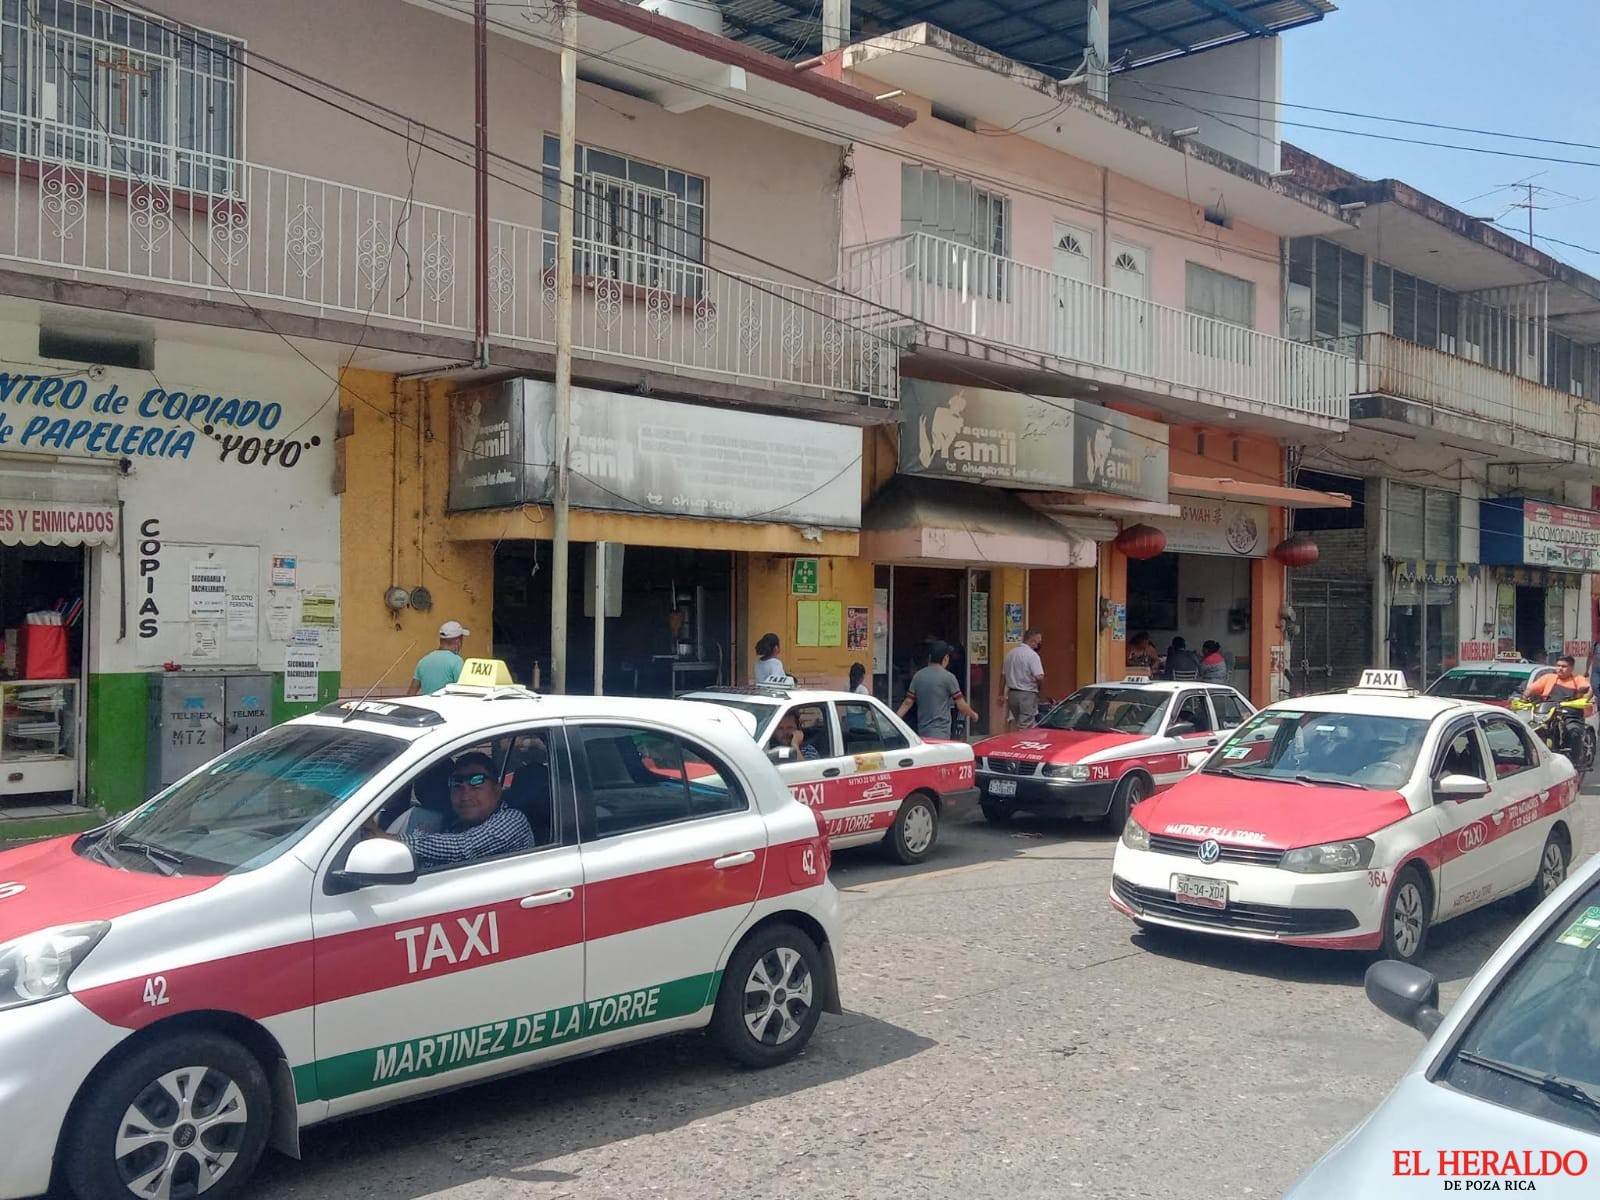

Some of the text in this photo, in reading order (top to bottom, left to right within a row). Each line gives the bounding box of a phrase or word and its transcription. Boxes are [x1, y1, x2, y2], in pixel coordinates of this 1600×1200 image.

[93, 384, 129, 414] de
[138, 388, 283, 431] COPIADO
[20, 415, 196, 459] PAPELERÍA
[18, 510, 28, 532] Y
[32, 511, 114, 533] ENMICADOS
[139, 519, 161, 639] COPIAS
[471, 661, 493, 677] TAXI
[1365, 672, 1398, 686] TAXI
[768, 676, 787, 684] TAXI
[233, 709, 265, 718] TELMEX
[959, 765, 972, 780] 278
[1092, 765, 1110, 779] 794
[844, 814, 875, 832] TORRE
[1164, 823, 1208, 836] MARTINEZ
[1208, 826, 1222, 836] DE
[1235, 830, 1266, 842] TORRE
[1463, 824, 1483, 848] TAXI
[803, 850, 816, 875] 42
[1368, 871, 1388, 888] 364
[395, 911, 499, 974] TAXI
[143, 976, 170, 1007] 42
[373, 987, 661, 1081] MARTINEZ DE LA TORRE
